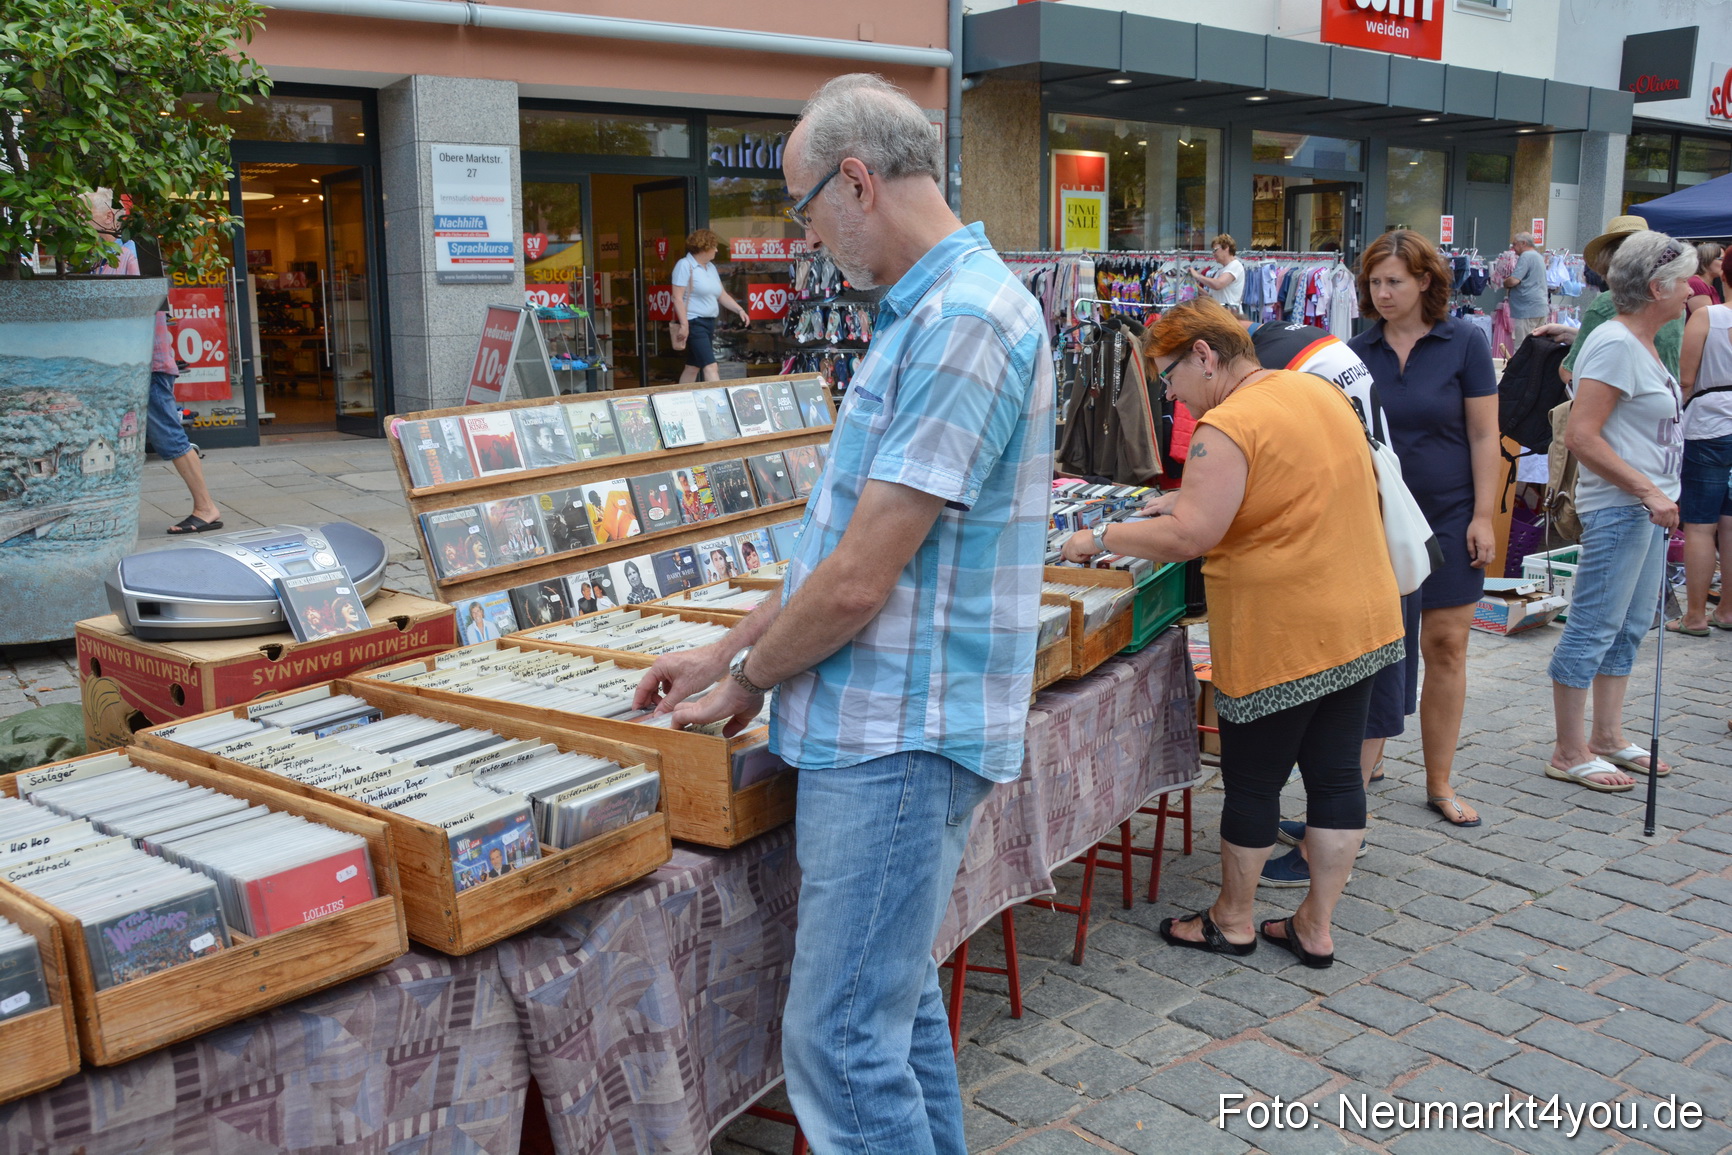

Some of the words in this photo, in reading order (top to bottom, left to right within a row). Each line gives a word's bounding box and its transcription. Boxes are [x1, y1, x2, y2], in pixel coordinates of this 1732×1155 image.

[1366, 20, 1409, 39] weiden
[439, 152, 464, 163] Obere
[466, 153, 503, 164] Marktstr.
[467, 168, 477, 178] 27
[1068, 204, 1097, 216] FINAL
[439, 217, 484, 229] Nachhilfe
[1068, 215, 1097, 229] SALE
[451, 243, 509, 256] Sprachkurse
[527, 237, 541, 249] SV
[734, 243, 756, 254] 10%
[762, 243, 784, 254] 30%
[167, 328, 225, 364] 0%
[80, 635, 132, 670] BANANAS
[350, 629, 429, 663] PREMIUM
[134, 655, 199, 688] PREMIUM
[252, 650, 343, 686] BANANAS
[29, 769, 78, 787] Schlager
[304, 771, 342, 787] ouskouri,
[439, 812, 476, 829] lksmusik
[8, 858, 71, 883] Soundtrack
[303, 899, 345, 922] LOLLIES
